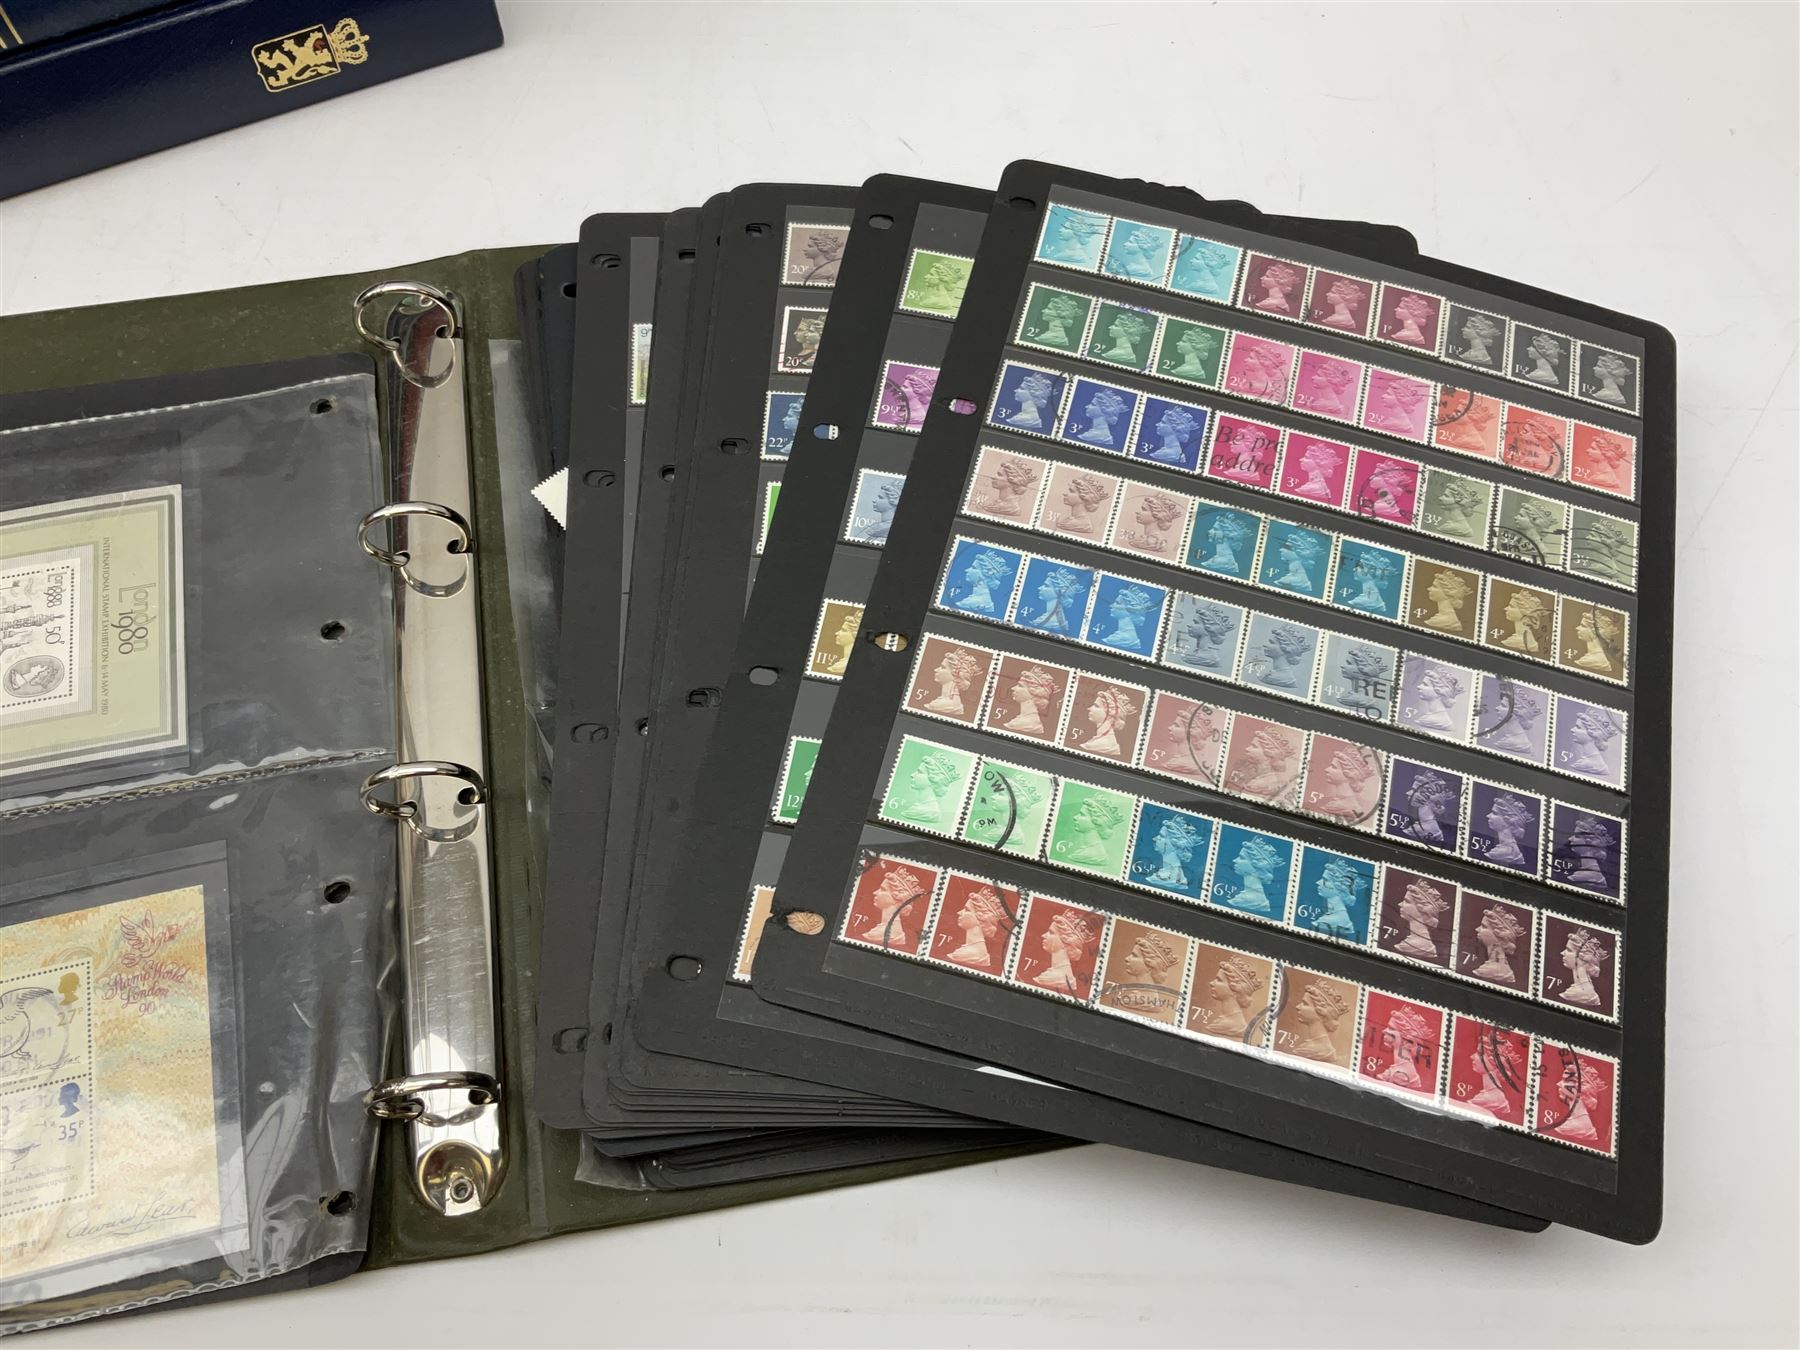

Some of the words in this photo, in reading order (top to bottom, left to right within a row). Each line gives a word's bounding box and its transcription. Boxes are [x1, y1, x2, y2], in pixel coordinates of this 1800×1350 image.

[1215, 425, 1245, 446] Be
[101, 536, 110, 592] INTERNATIONAL
[101, 594, 110, 617] STAMP
[101, 619, 109, 663] EXHIBITION
[111, 609, 141, 654] 1980
[101, 680, 109, 697] MAY
